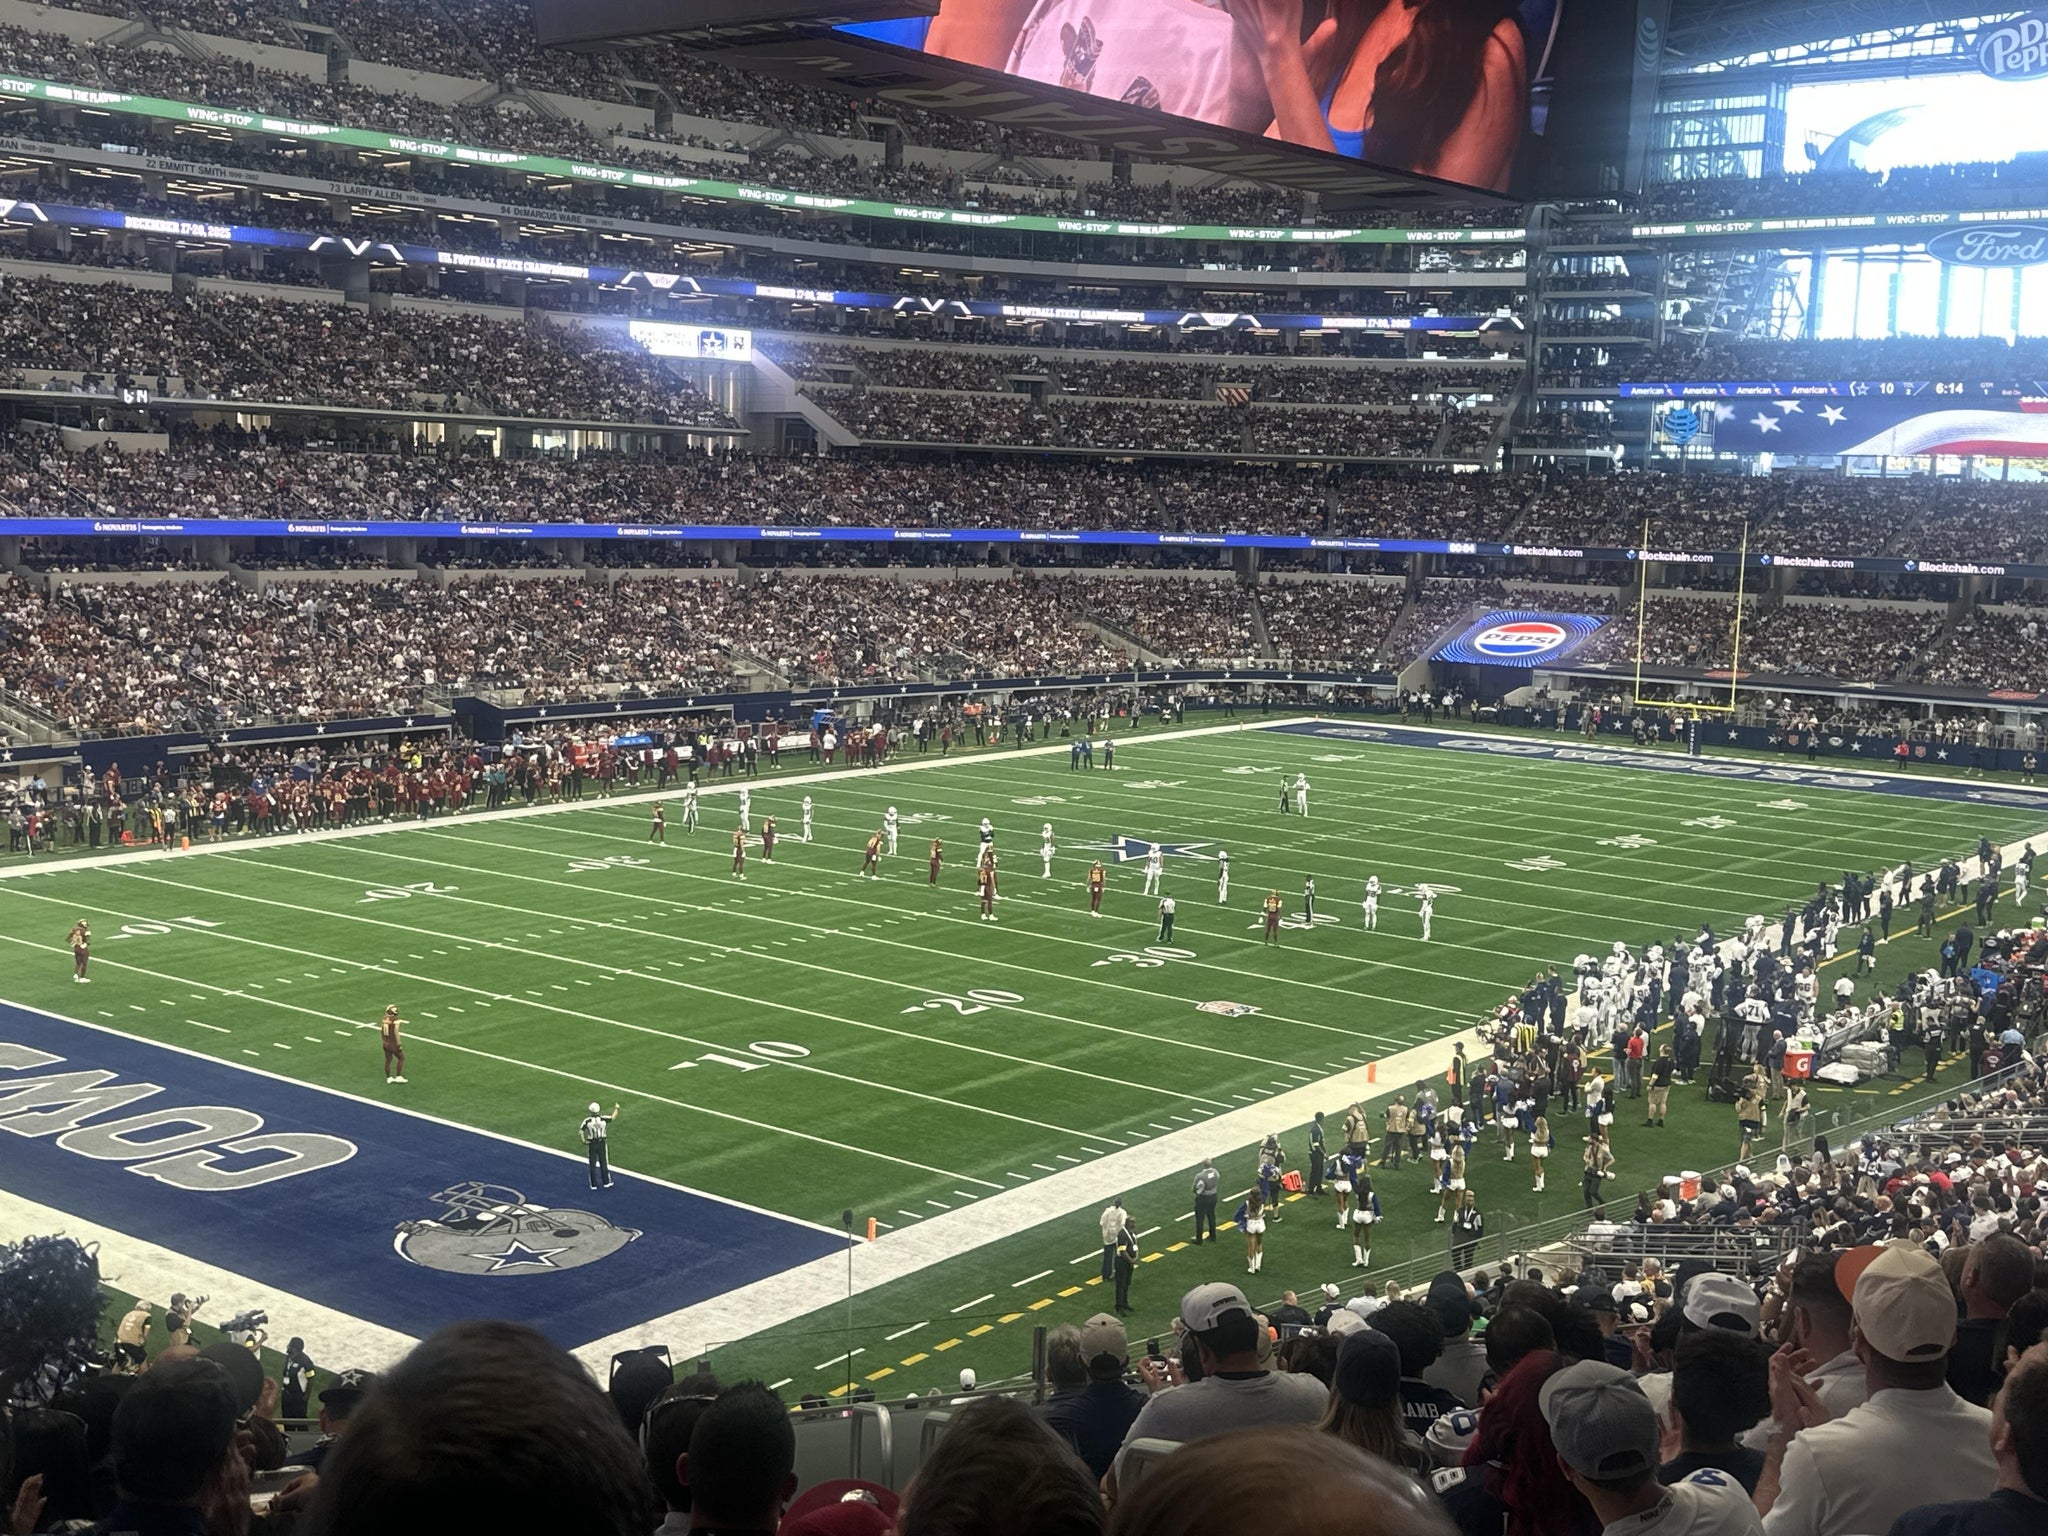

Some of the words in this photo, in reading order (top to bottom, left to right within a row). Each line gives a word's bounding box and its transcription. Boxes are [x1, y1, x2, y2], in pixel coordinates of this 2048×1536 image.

[2019, 19, 2048, 48] D
[146, 159, 156, 168] 22
[159, 161, 196, 173] EMMITT
[198, 166, 227, 178] SMITH
[329, 183, 341, 193] 73
[343, 185, 373, 196] LARRY
[375, 188, 403, 200] ALLEN
[559, 213, 582, 224] WARE
[1955, 231, 2046, 261] Ford
[1631, 387, 1664, 395] American
[1683, 387, 1717, 395] American
[1736, 386, 1771, 395] American
[1791, 386, 1828, 395] American
[1879, 383, 1894, 394] 10
[1935, 382, 1964, 394] 6:14
[102, 523, 137, 532] NOVARTIS
[1513, 545, 1583, 558] Blockchain.com
[1773, 555, 1854, 568] Blockchain.com
[1918, 561, 2005, 575] Blockchain.com
[1483, 633, 1558, 644] PEPSI
[567, 856, 651, 870] 30
[365, 882, 459, 899] 20
[121, 915, 226, 935] 10
[1107, 946, 1197, 967] 30
[923, 989, 1024, 1015] 20
[1748, 1005, 1759, 1017] 71
[696, 1041, 811, 1072] 10
[1796, 1057, 1808, 1072] G
